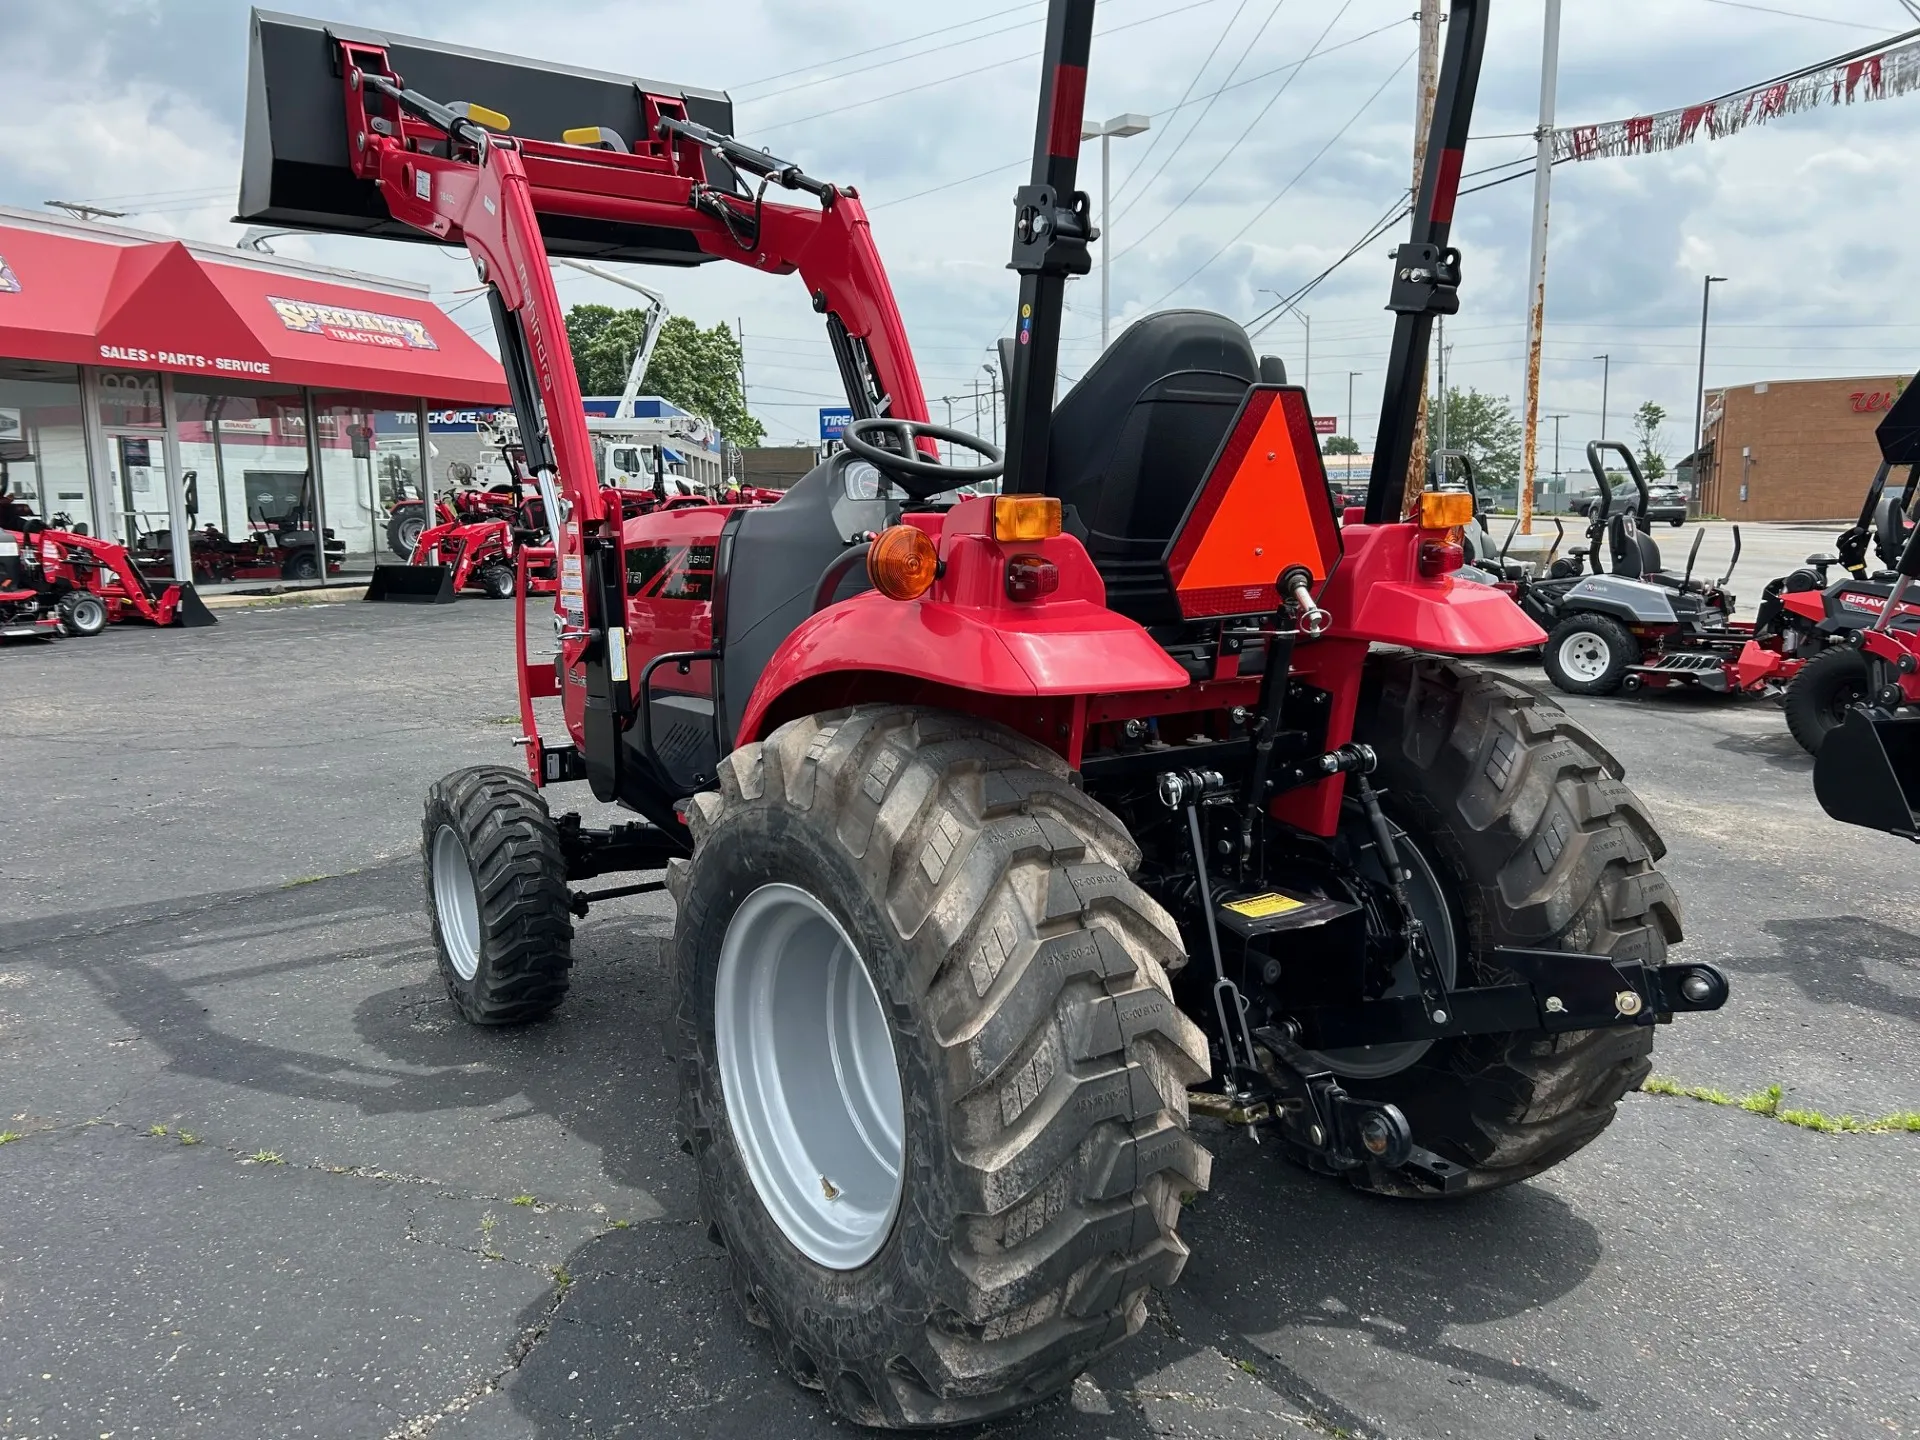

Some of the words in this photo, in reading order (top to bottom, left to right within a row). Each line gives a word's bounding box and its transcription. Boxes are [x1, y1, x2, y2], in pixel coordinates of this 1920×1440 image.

[275, 302, 430, 346] SPECIALTY
[328, 328, 403, 347] TRACTORS
[519, 263, 552, 392] mahindra
[100, 345, 148, 361] SALES
[158, 351, 205, 367] PARTS
[215, 358, 270, 374] SERVICE
[395, 412, 418, 424] TIR
[427, 410, 477, 425] CHOICE
